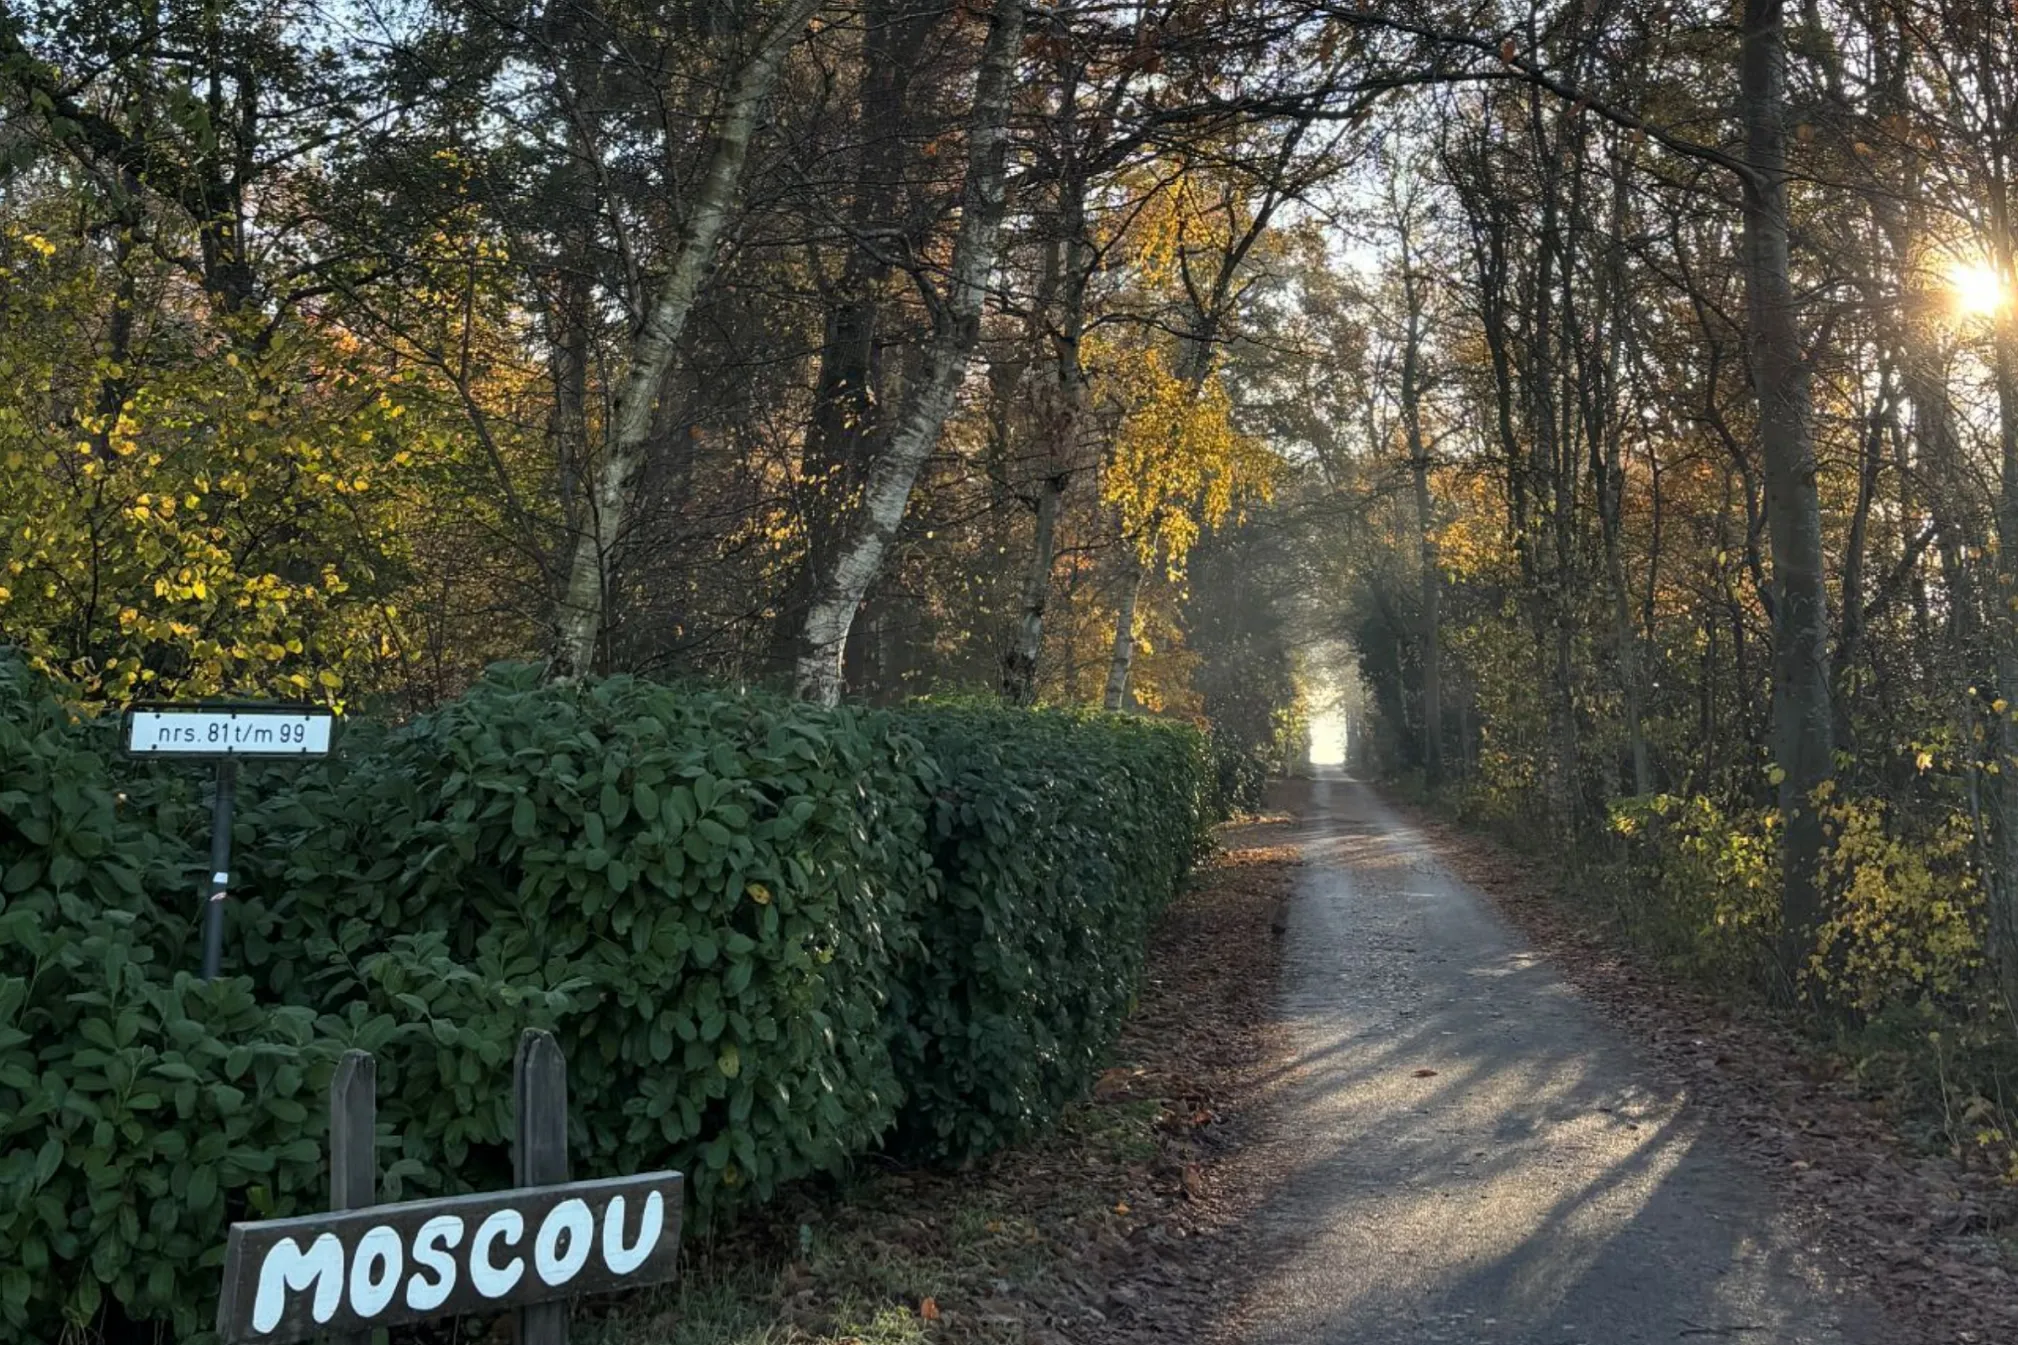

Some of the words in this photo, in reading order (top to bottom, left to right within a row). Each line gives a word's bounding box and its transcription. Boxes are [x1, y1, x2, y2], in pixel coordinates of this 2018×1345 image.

[158, 726, 201, 743] nrs.
[207, 722, 229, 743] 81
[234, 723, 273, 743] t/m
[279, 723, 305, 743] 99
[252, 1190, 664, 1333] MOSCOU
